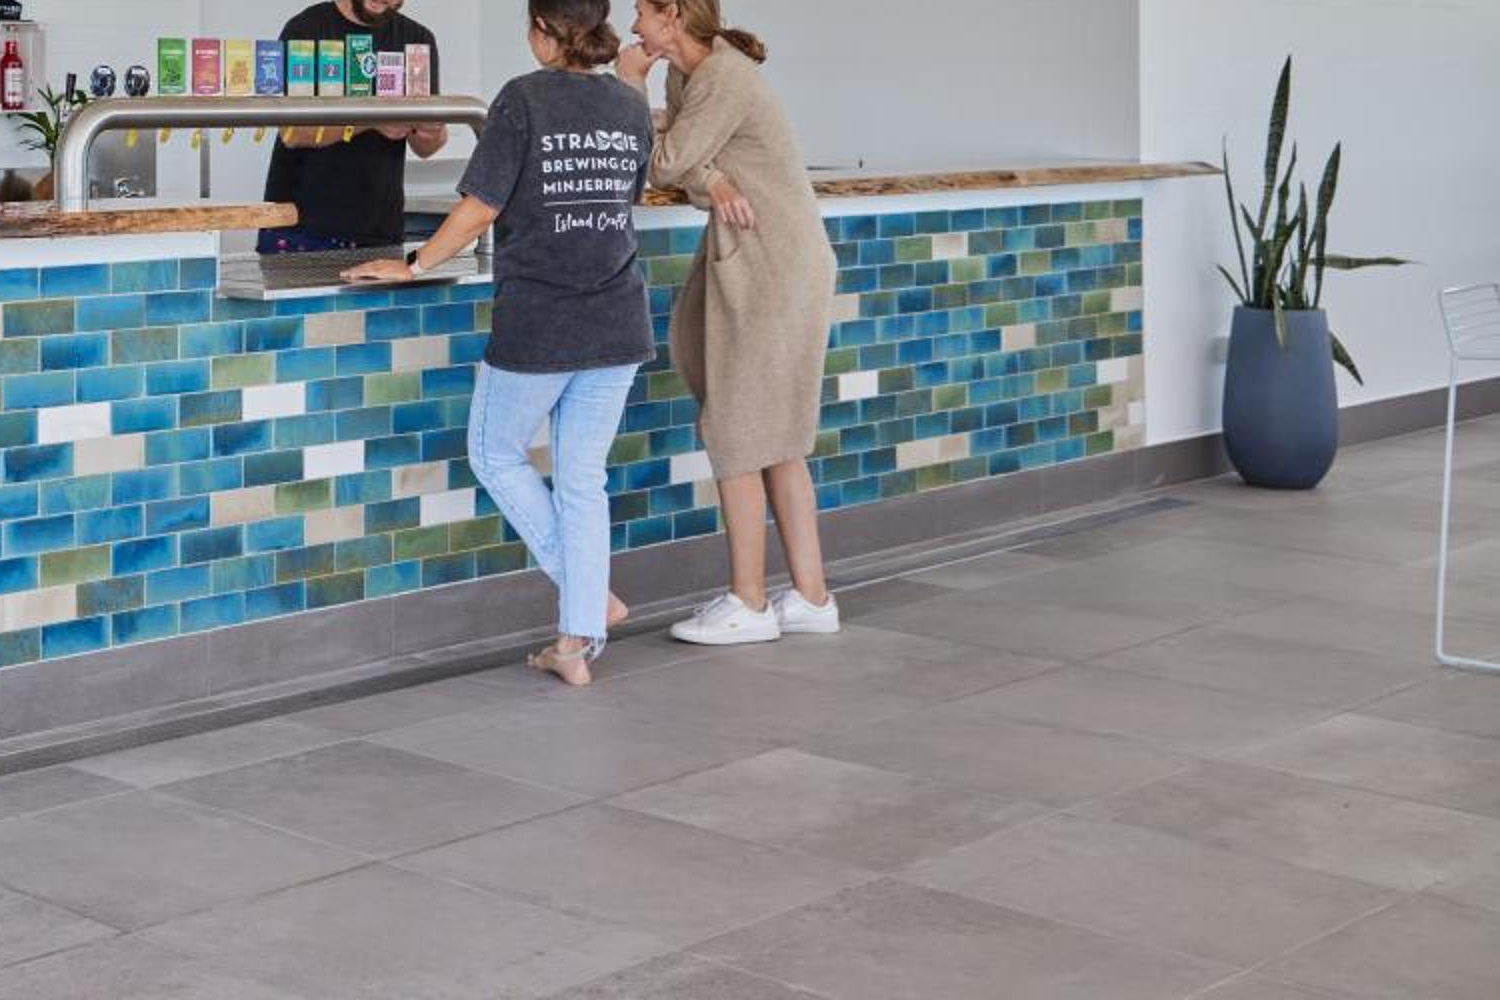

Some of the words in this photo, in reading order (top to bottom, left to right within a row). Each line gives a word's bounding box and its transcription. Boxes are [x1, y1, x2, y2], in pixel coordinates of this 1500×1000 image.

[541, 130, 639, 153] STRADDIE
[542, 157, 619, 173] BREWING
[621, 158, 638, 172] CO
[555, 212, 593, 233] Island
